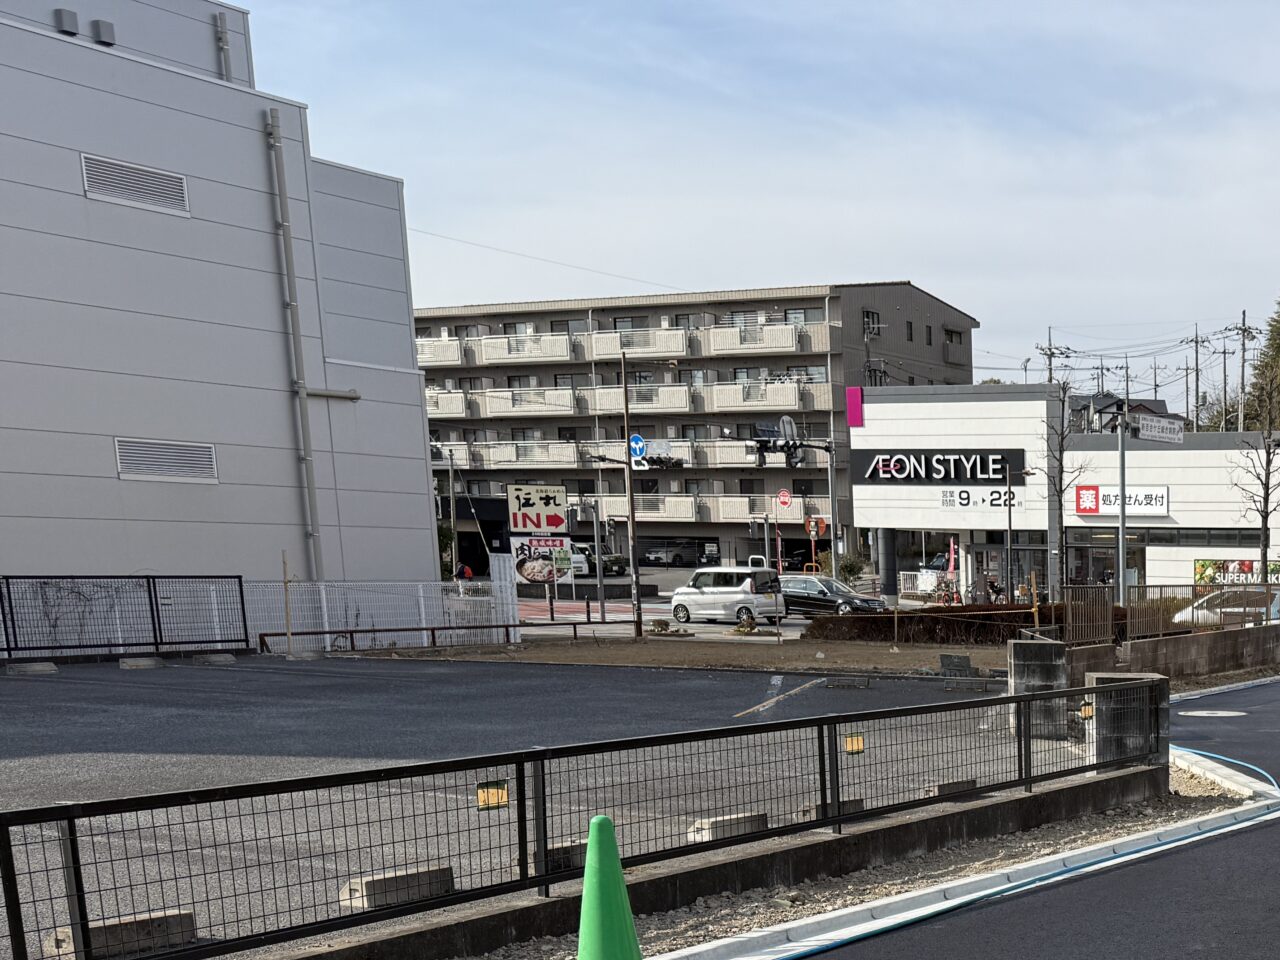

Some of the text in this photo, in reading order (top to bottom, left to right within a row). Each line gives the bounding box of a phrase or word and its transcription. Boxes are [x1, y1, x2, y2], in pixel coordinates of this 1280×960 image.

[931, 454, 1003, 479] STYLE
[1079, 489, 1097, 510] 薬
[1101, 494, 1165, 507] 処方せん受付
[512, 512, 542, 529] IN
[1215, 572, 1246, 583] SUPER
